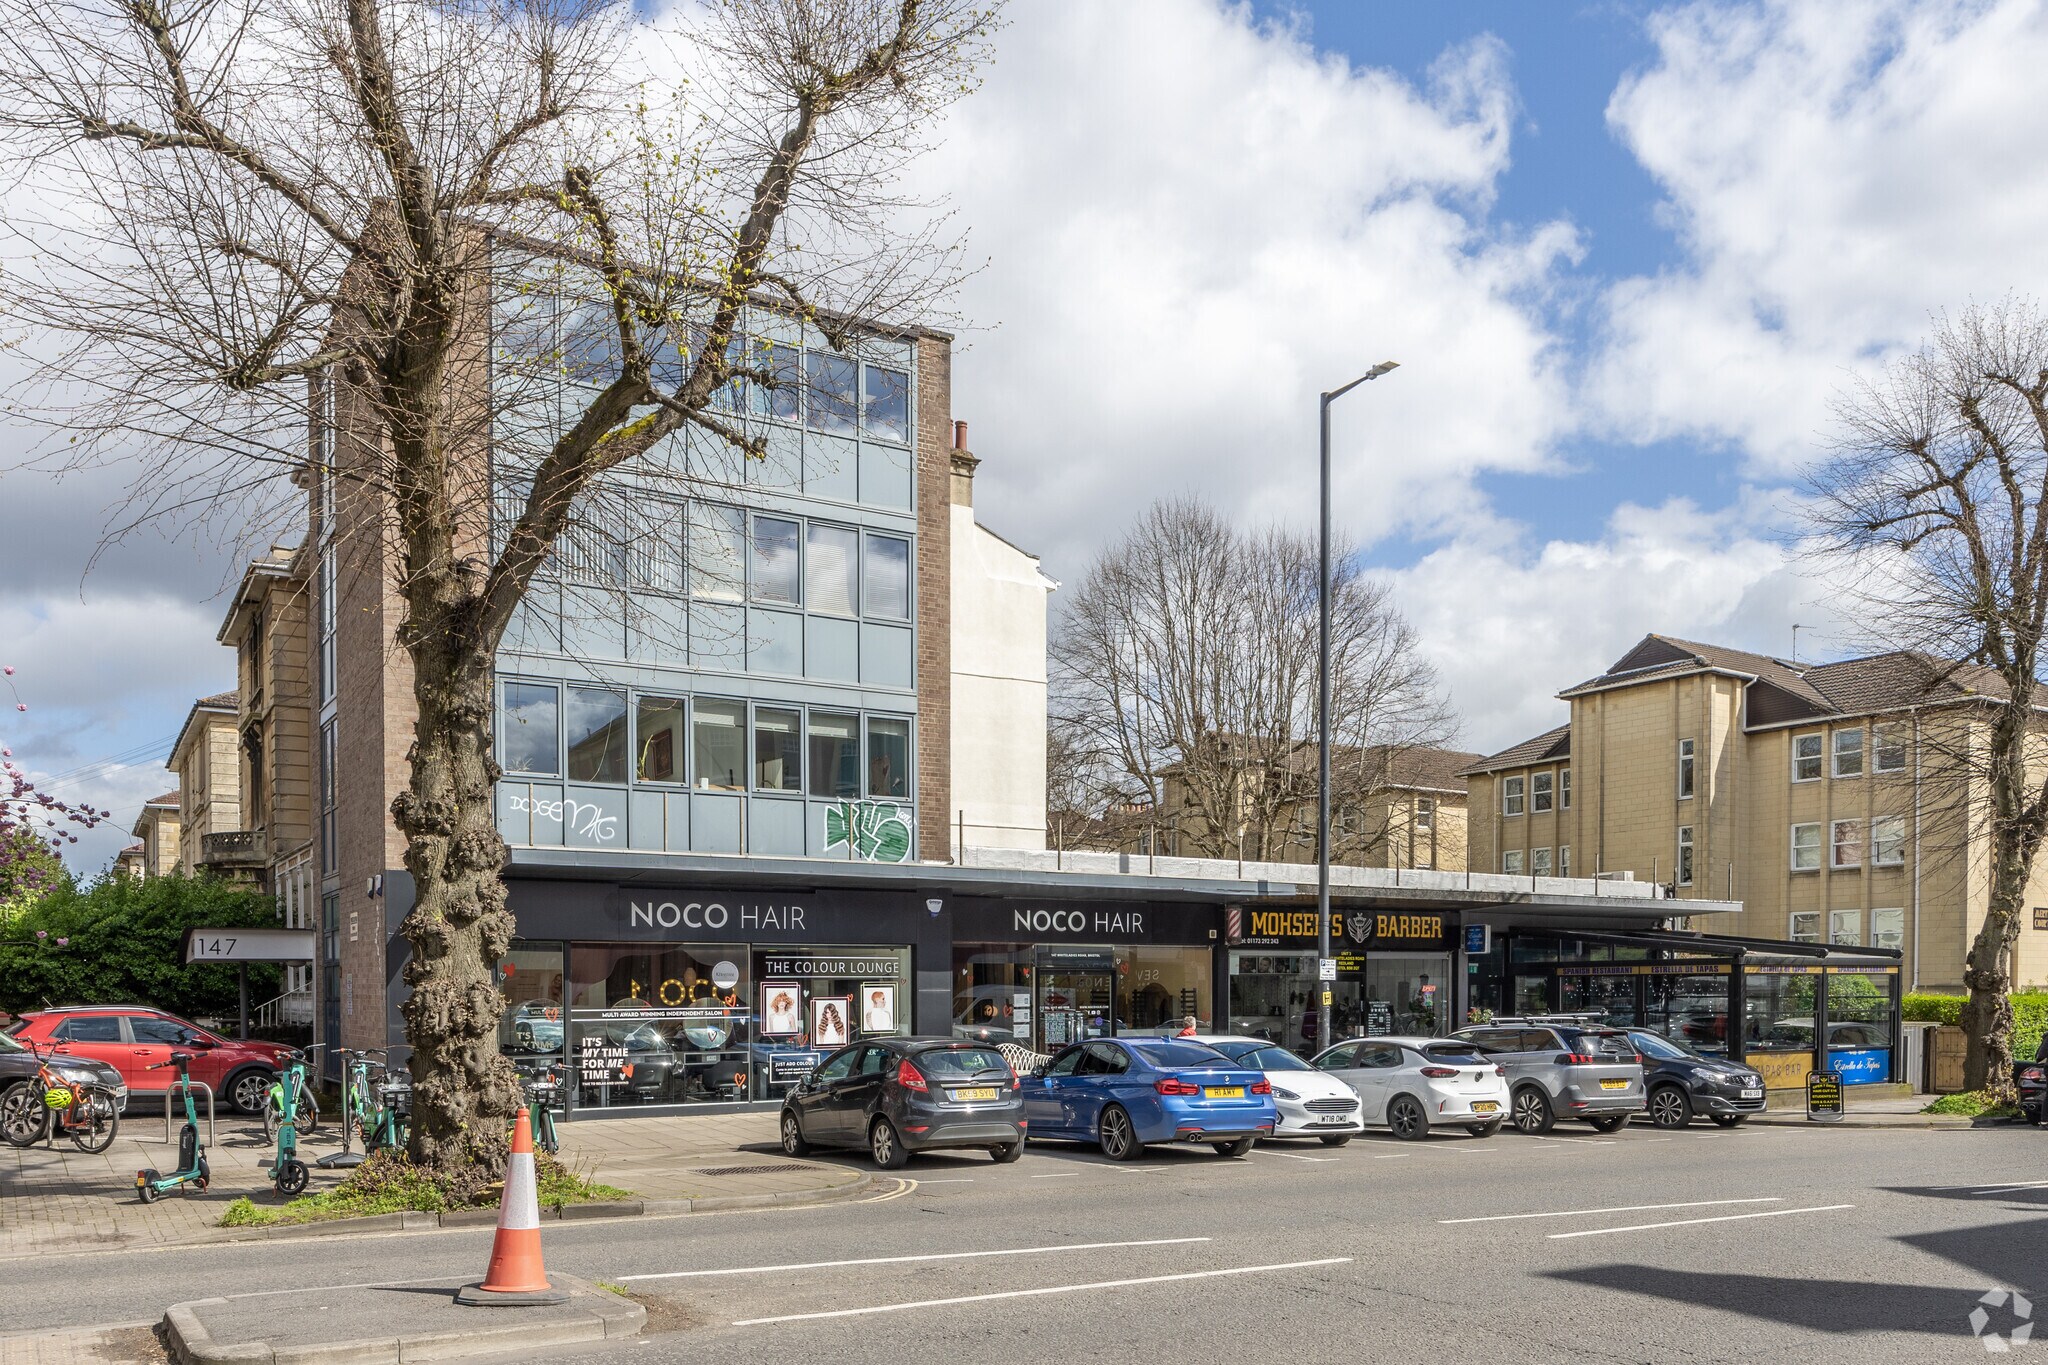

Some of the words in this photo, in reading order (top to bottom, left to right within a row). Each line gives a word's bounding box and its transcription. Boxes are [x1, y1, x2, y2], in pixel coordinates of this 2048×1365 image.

[631, 901, 728, 928] NOCO
[741, 905, 806, 930] HAIR
[1014, 909, 1086, 932] NOCO
[1095, 912, 1144, 933] HAIR
[1376, 915, 1443, 938] BARBER
[199, 938, 237, 956] 147
[766, 961, 790, 973] THE
[795, 961, 846, 973] COLOUR
[850, 962, 899, 973] LOUNGE
[1562, 967, 1591, 975] SPANISH
[1592, 966, 1633, 974] RESTAURANT
[1685, 965, 1694, 973] DE
[1696, 965, 1719, 973] TAPAS
[582, 1036, 602, 1047] IT'S
[582, 1048, 601, 1058] MY
[601, 1047, 629, 1057] TIME
[582, 1059, 605, 1069] FOR
[607, 1058, 624, 1068] ME
[1833, 1059, 1856, 1071] Estrella
[1856, 1060, 1864, 1070] de
[1864, 1057, 1880, 1073] Tapas
[582, 1070, 610, 1080] TIME
[1785, 1063, 1801, 1076] BAR
[979, 1088, 994, 1098] SYU
[1223, 1088, 1236, 1096] AMY
[1321, 1115, 1335, 1123] WT18
